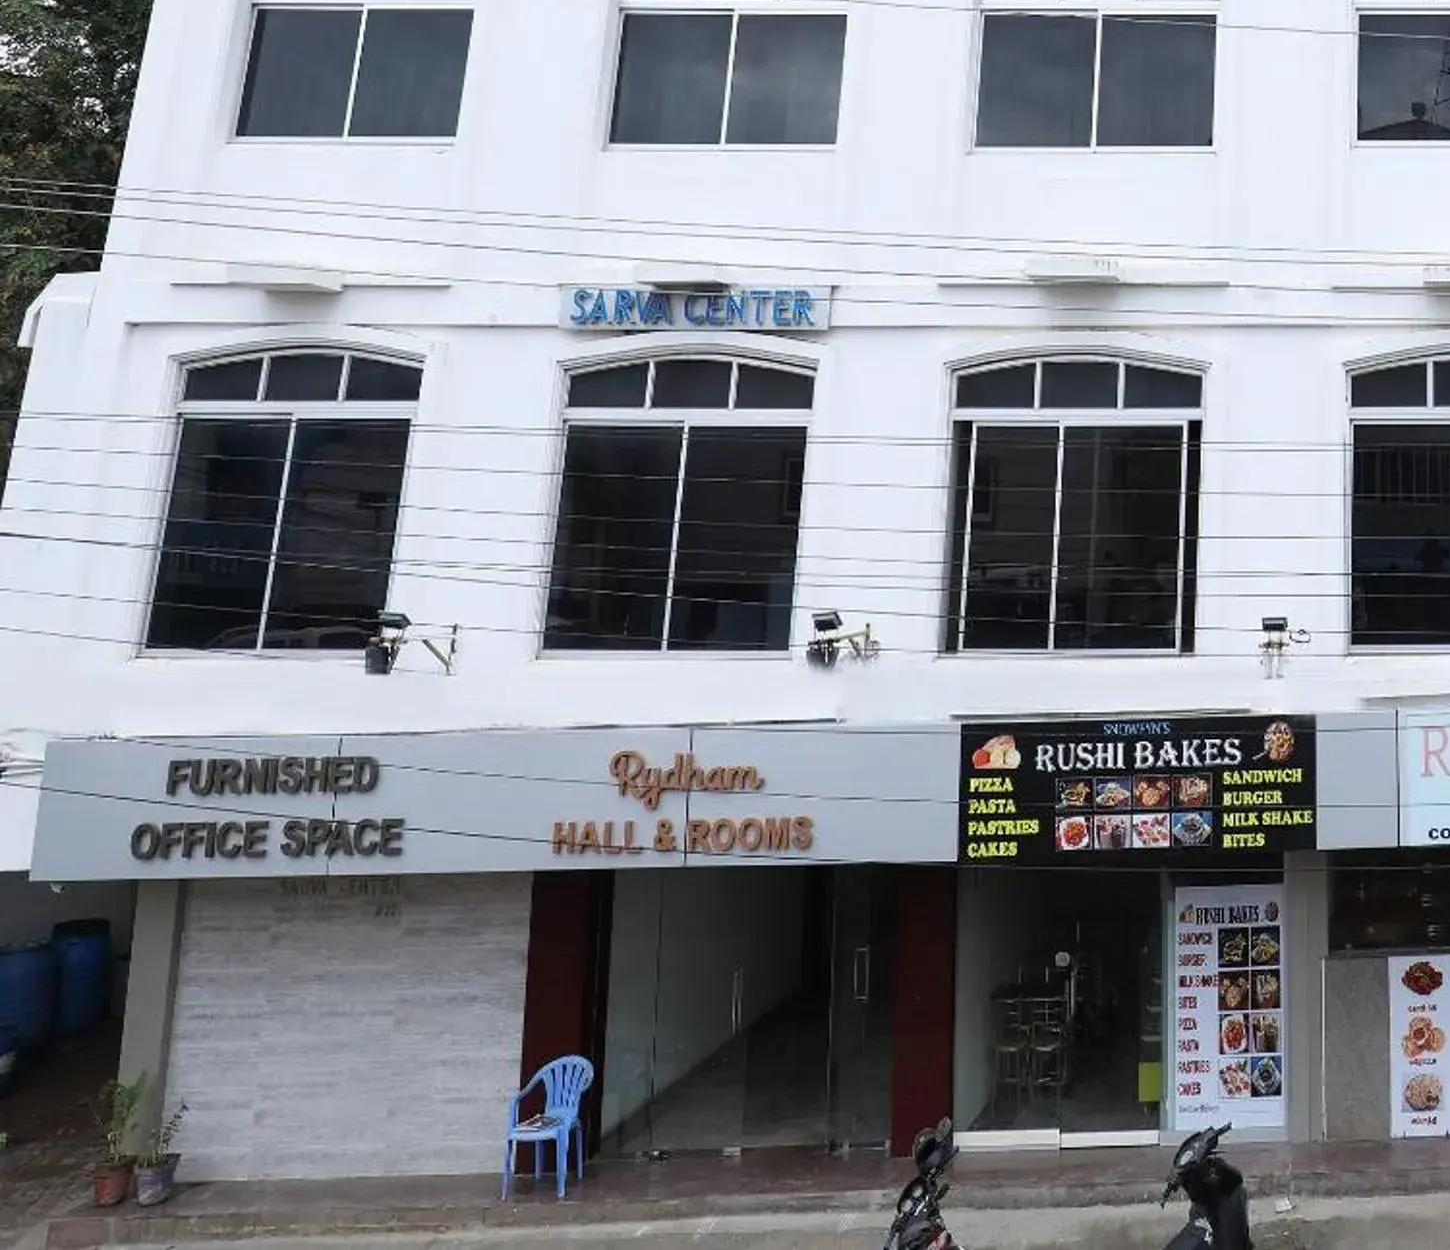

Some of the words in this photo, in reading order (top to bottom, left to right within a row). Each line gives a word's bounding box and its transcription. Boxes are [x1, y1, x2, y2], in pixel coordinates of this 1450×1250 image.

[570, 289, 672, 326] SARVA
[684, 290, 814, 327] CENTER
[1035, 742, 1126, 772] RUSHI
[1134, 739, 1242, 768] BAKES
[165, 756, 380, 796] FURNISHED
[609, 751, 764, 810] Rydham
[1222, 769, 1303, 786] SANDWICH
[969, 777, 1013, 793] PIZZA
[968, 799, 1016, 815] PASTA
[1222, 791, 1283, 807] BURGER
[968, 820, 1039, 836] PASTRIES
[1222, 812, 1258, 828] MILK
[1262, 811, 1313, 826] SHAKE
[130, 821, 270, 860] OFFICE
[280, 818, 405, 858] SPACE
[552, 820, 643, 854] HALL
[653, 819, 677, 853] &
[687, 816, 814, 851] ROOMS
[1222, 833, 1265, 848] BITES
[968, 841, 1017, 858] CAKES
